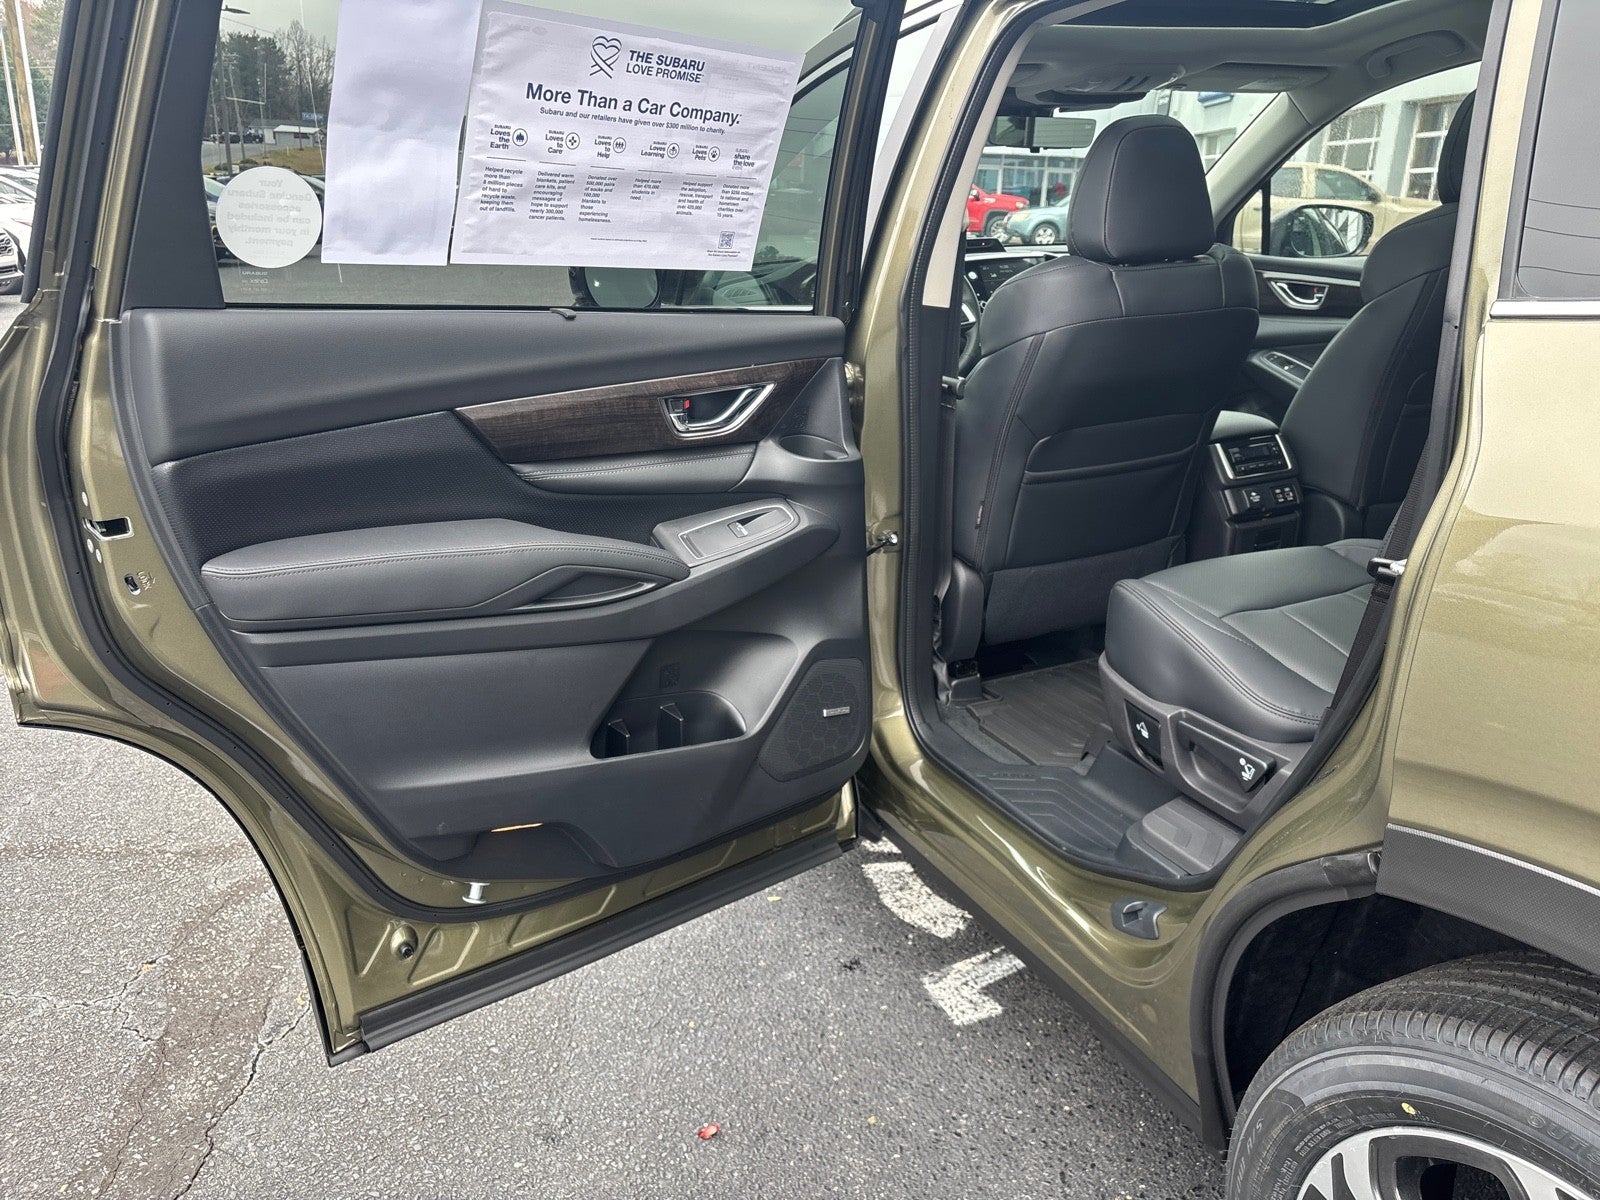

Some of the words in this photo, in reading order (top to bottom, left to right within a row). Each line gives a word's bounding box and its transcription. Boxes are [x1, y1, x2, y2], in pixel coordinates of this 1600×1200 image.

[629, 50, 653, 64] THE
[656, 55, 705, 71] SUBARU
[626, 63, 653, 76] LOVE
[526, 83, 571, 104] More
[578, 89, 618, 109] Than
[623, 100, 632, 111] a
[638, 98, 666, 115] Car
[540, 107, 564, 118] Subaru
[591, 114, 616, 124] retailers
[666, 121, 679, 129] $300
[680, 123, 699, 132] million
[706, 126, 725, 135] charity.
[546, 134, 564, 142] Loves
[490, 142, 509, 150] Earth
[641, 150, 665, 158] Learning
[692, 148, 707, 156] Loves
